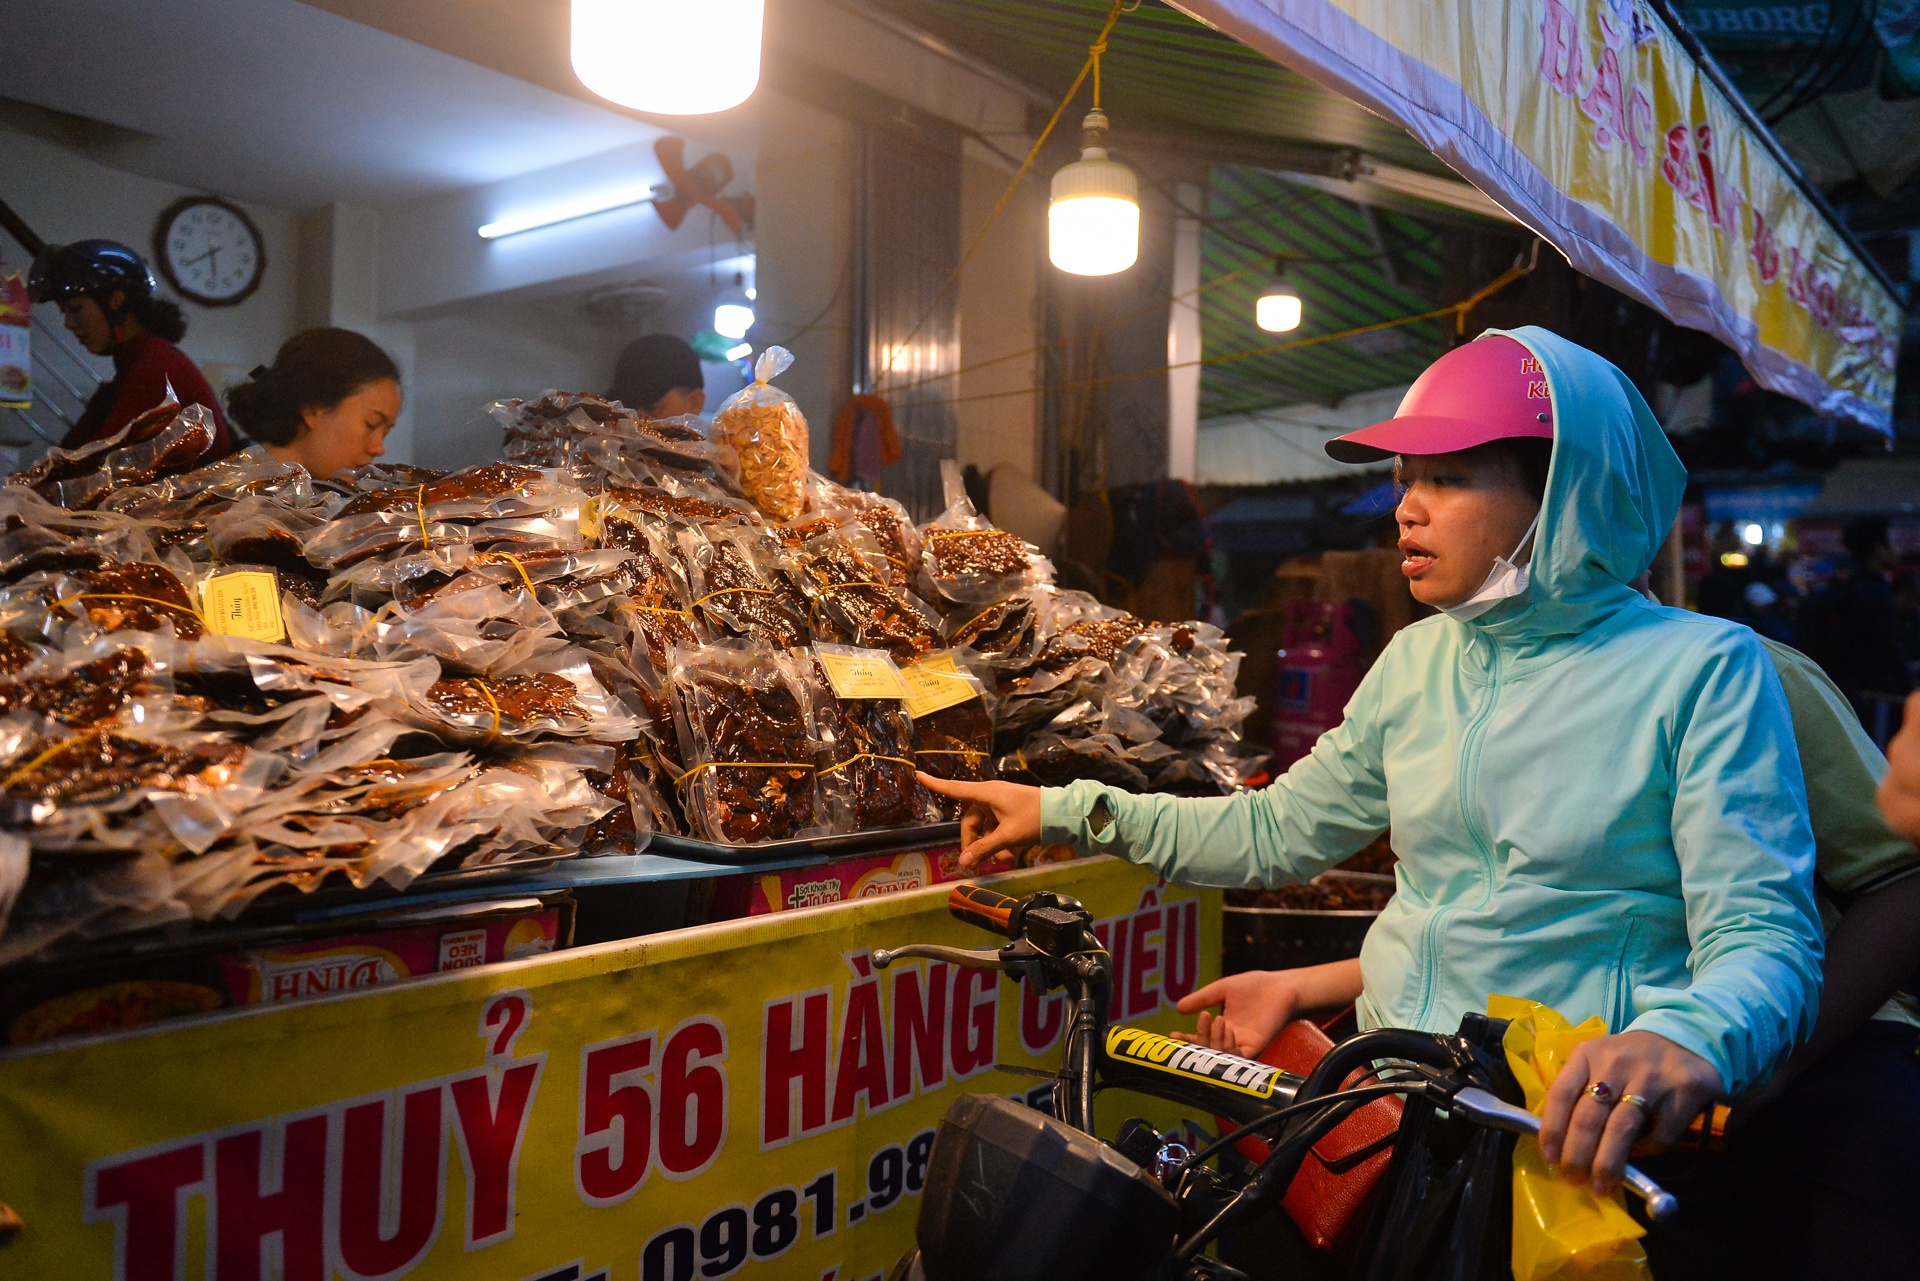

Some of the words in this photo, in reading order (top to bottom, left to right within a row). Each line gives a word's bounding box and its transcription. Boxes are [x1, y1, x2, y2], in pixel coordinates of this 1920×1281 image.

[449, 943, 478, 958] HEO
[577, 1018, 728, 1202] 56
[762, 952, 1000, 1147] HÀNG
